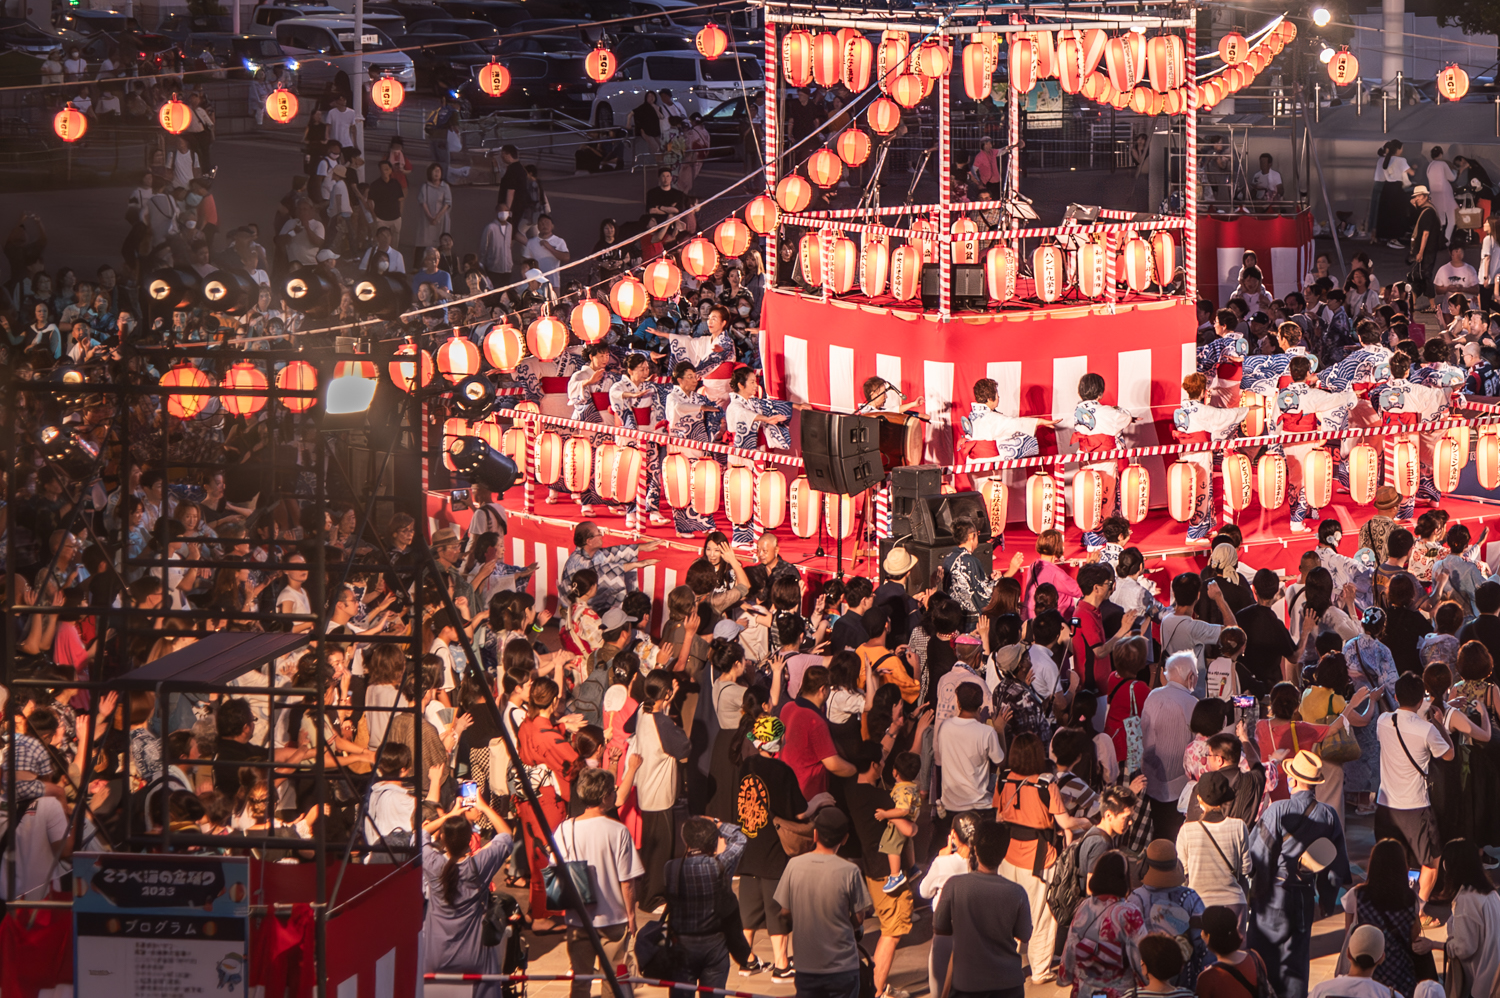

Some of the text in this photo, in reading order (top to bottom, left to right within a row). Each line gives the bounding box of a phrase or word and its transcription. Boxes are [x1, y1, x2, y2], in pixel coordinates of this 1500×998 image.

[1406, 461, 1415, 487] umie
[103, 868, 216, 886] こうべ海の盆踊り
[141, 886, 176, 897] 2023
[125, 919, 197, 936] プログラム
